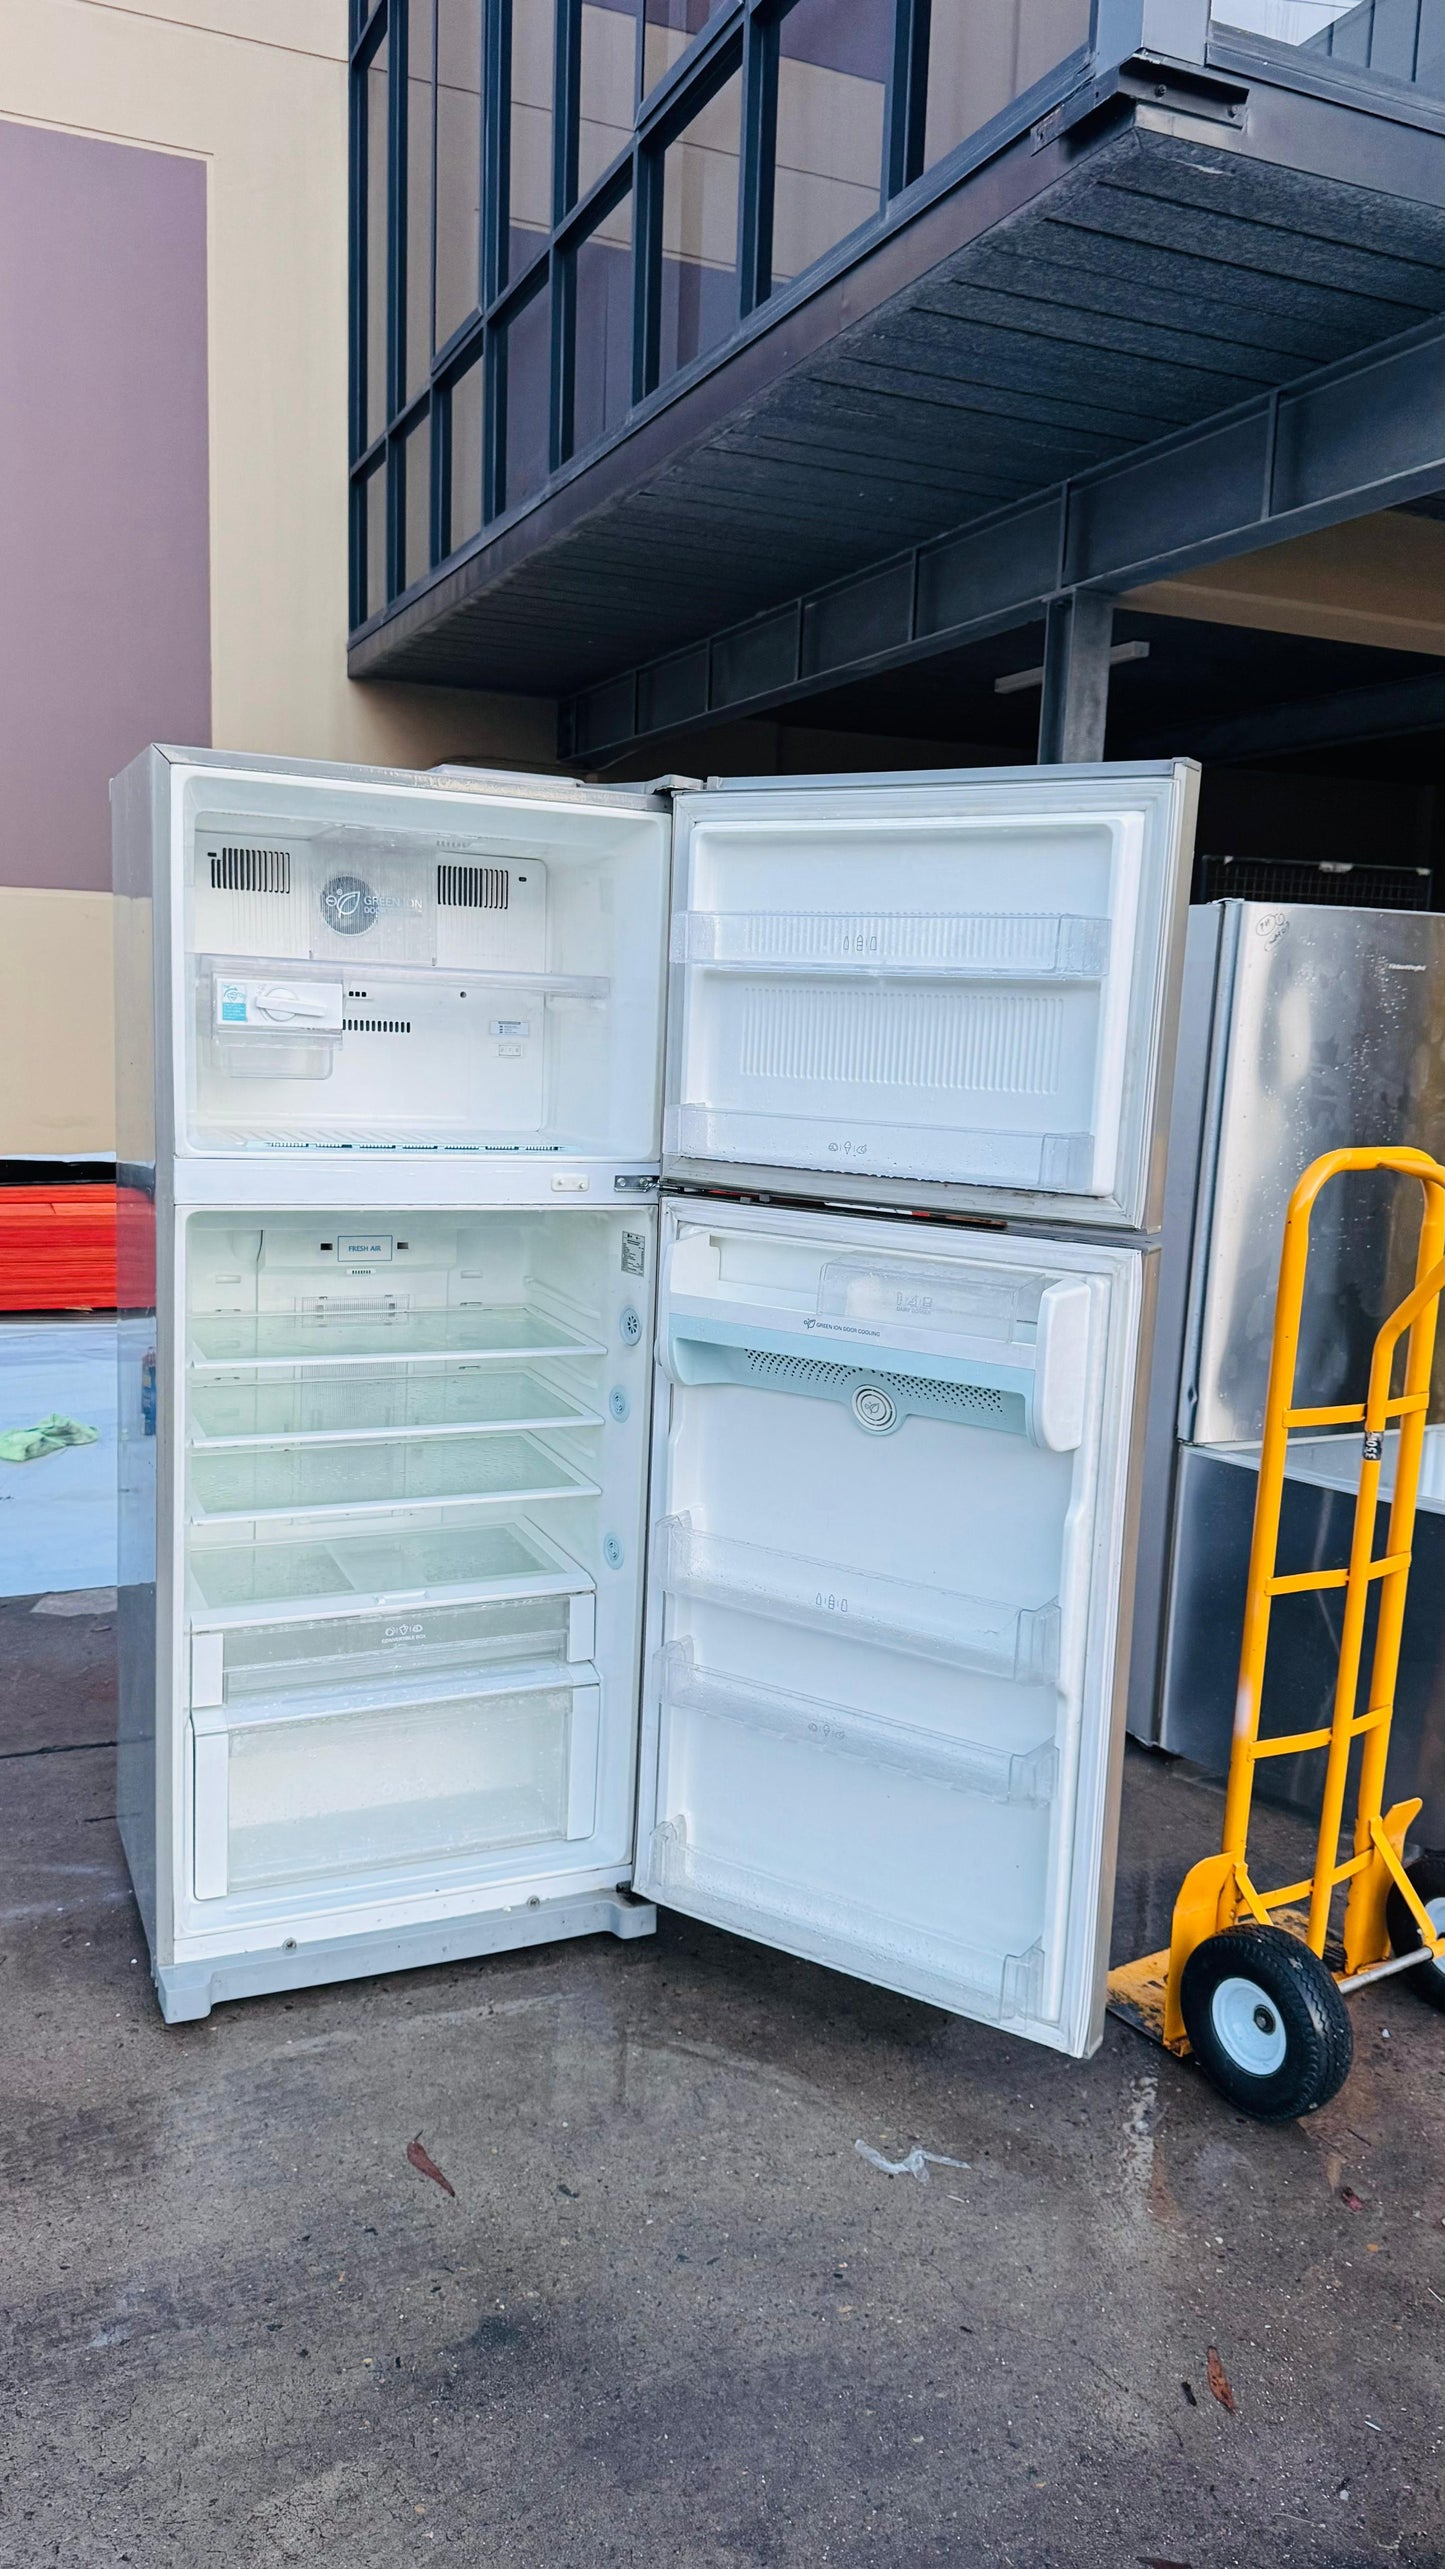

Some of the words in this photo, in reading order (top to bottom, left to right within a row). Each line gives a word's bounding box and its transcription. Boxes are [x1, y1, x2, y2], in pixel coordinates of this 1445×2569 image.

[363, 895, 401, 908] GREEN
[816, 1322, 833, 1330] GREEN
[843, 1326, 858, 1334] DOOR
[858, 1328, 881, 1337] COOLING
